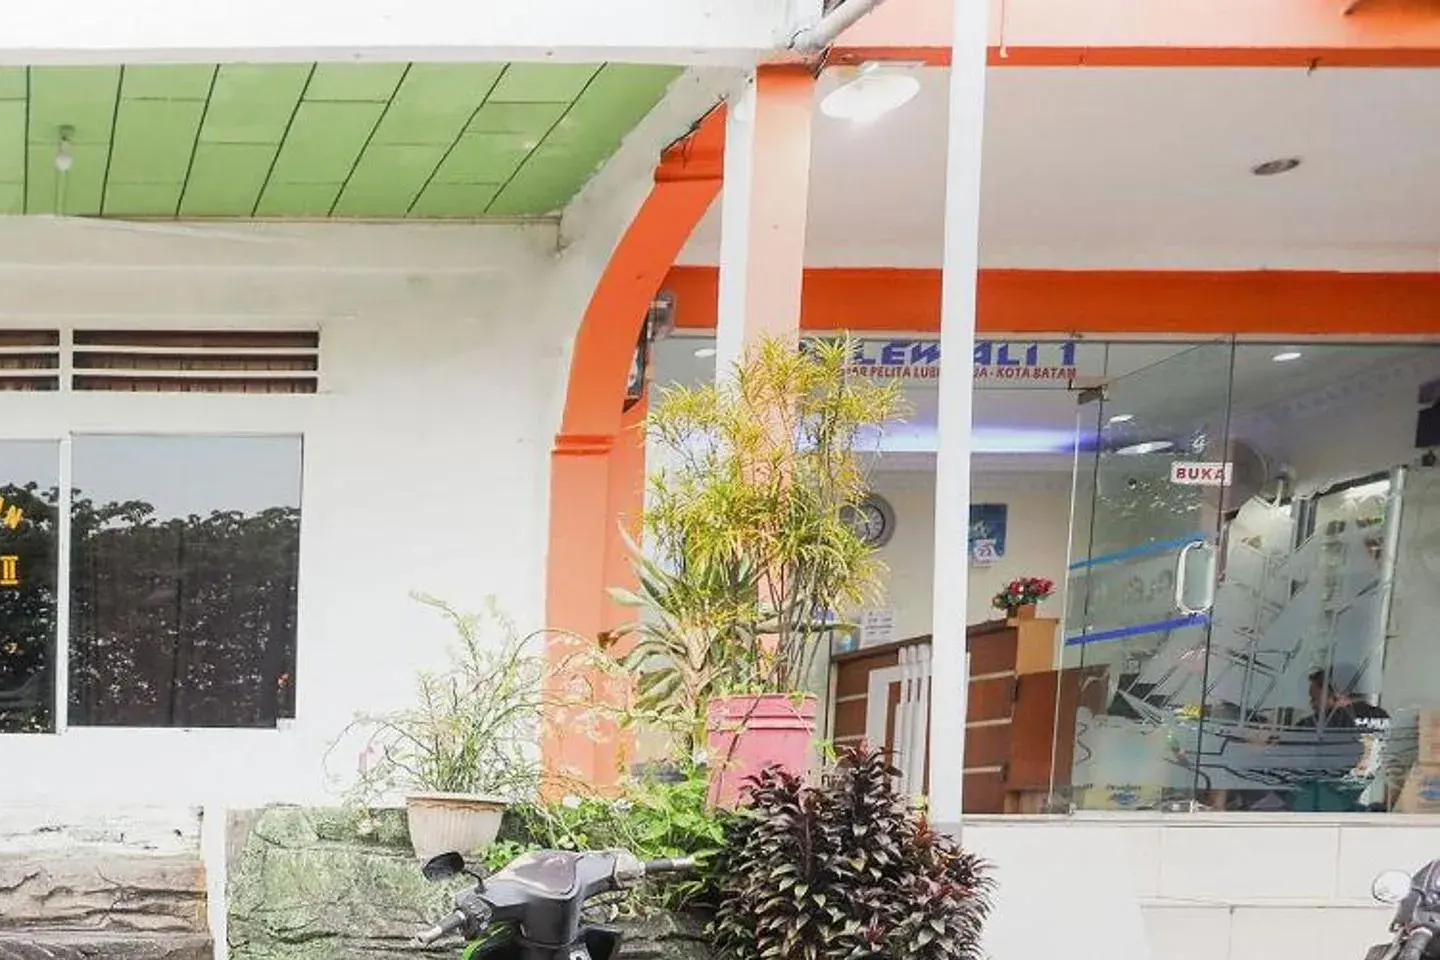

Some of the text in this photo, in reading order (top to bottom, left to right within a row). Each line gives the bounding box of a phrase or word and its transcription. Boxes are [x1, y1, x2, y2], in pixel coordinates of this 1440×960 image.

[870, 366, 911, 378] PELITA
[913, 366, 940, 378] LUB
[996, 367, 1030, 379] KOTA
[1032, 367, 1077, 379] BATAM
[1175, 467, 1225, 480] BUKA
[0, 555, 19, 585] II
